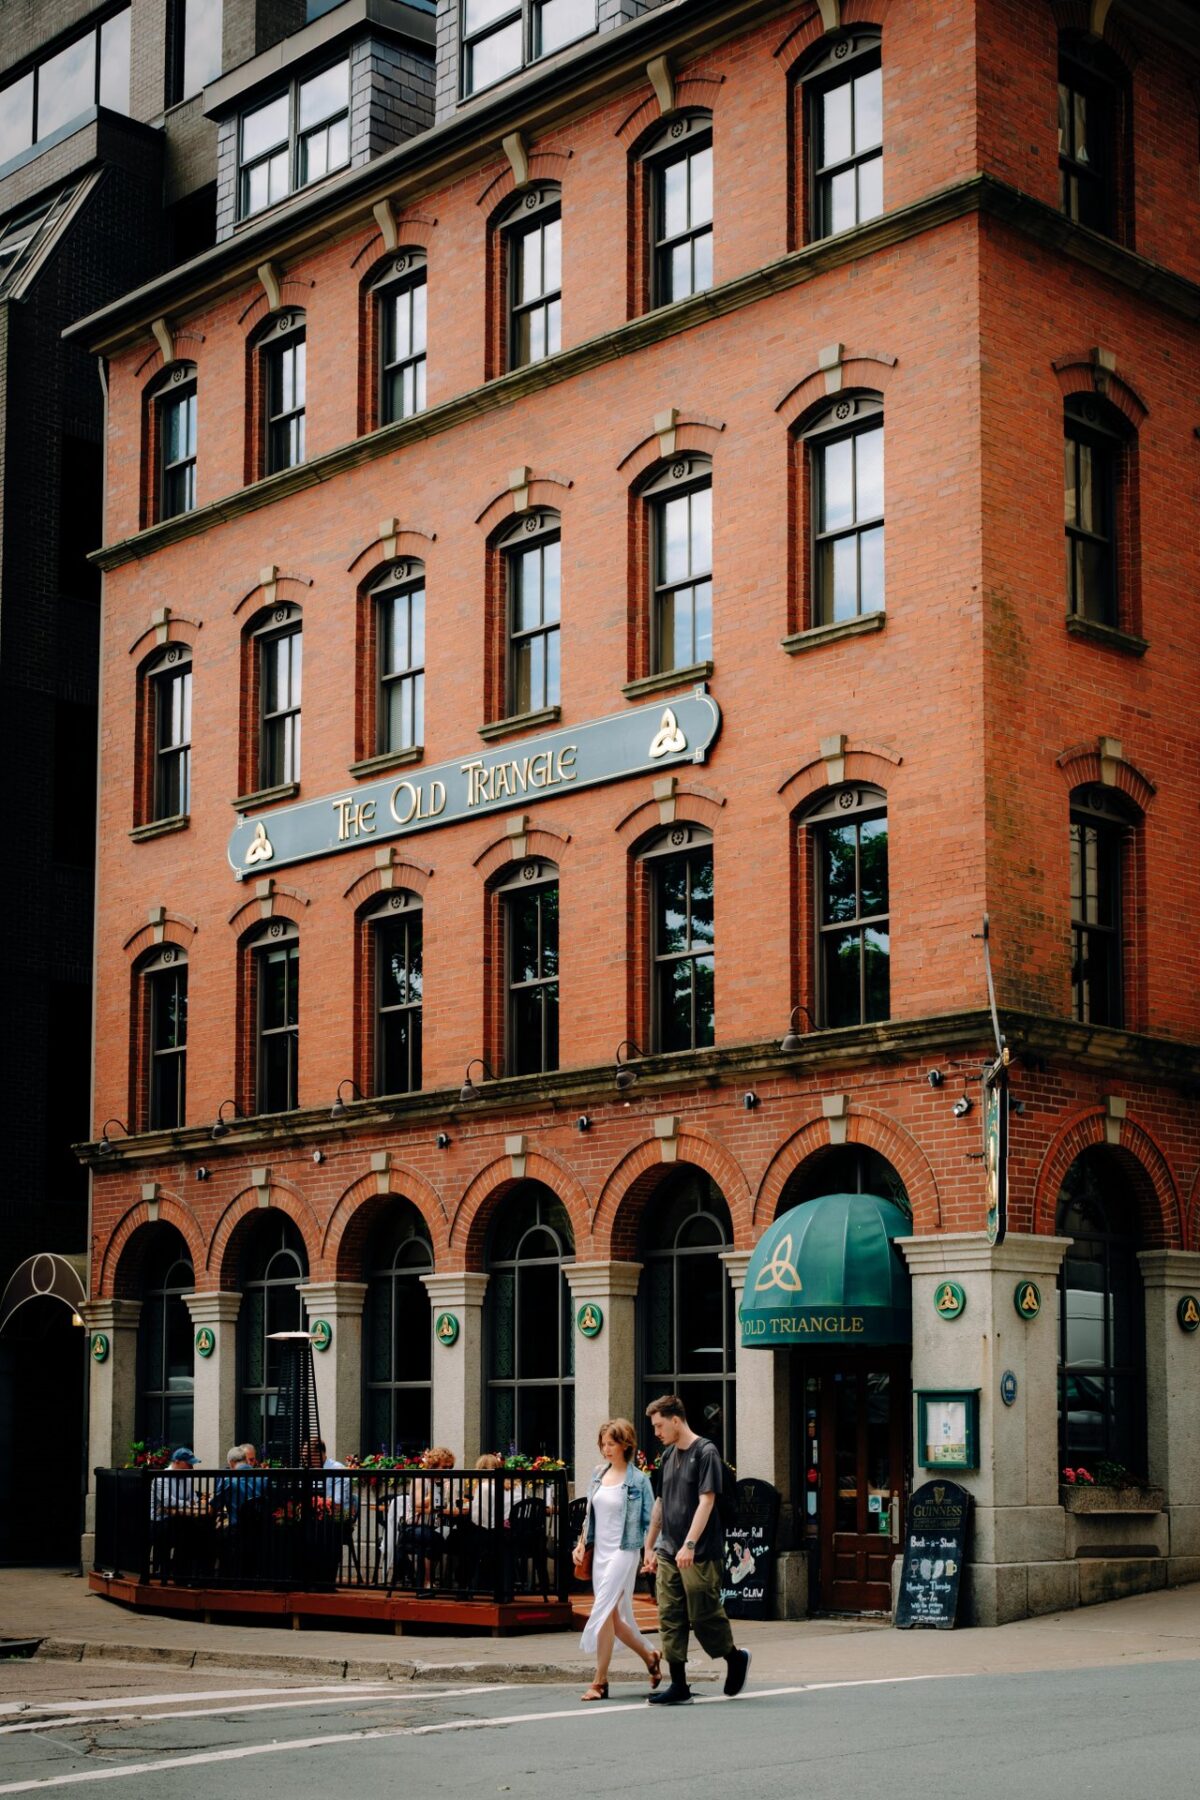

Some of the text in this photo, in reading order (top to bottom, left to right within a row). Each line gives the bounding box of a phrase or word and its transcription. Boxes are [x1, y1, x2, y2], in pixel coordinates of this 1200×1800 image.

[745, 1320, 766, 1335] OLD
[769, 1317, 864, 1333] TRIANGLE
[913, 1504, 963, 1517] GUINNESS
[751, 1526, 763, 1538] Roll
